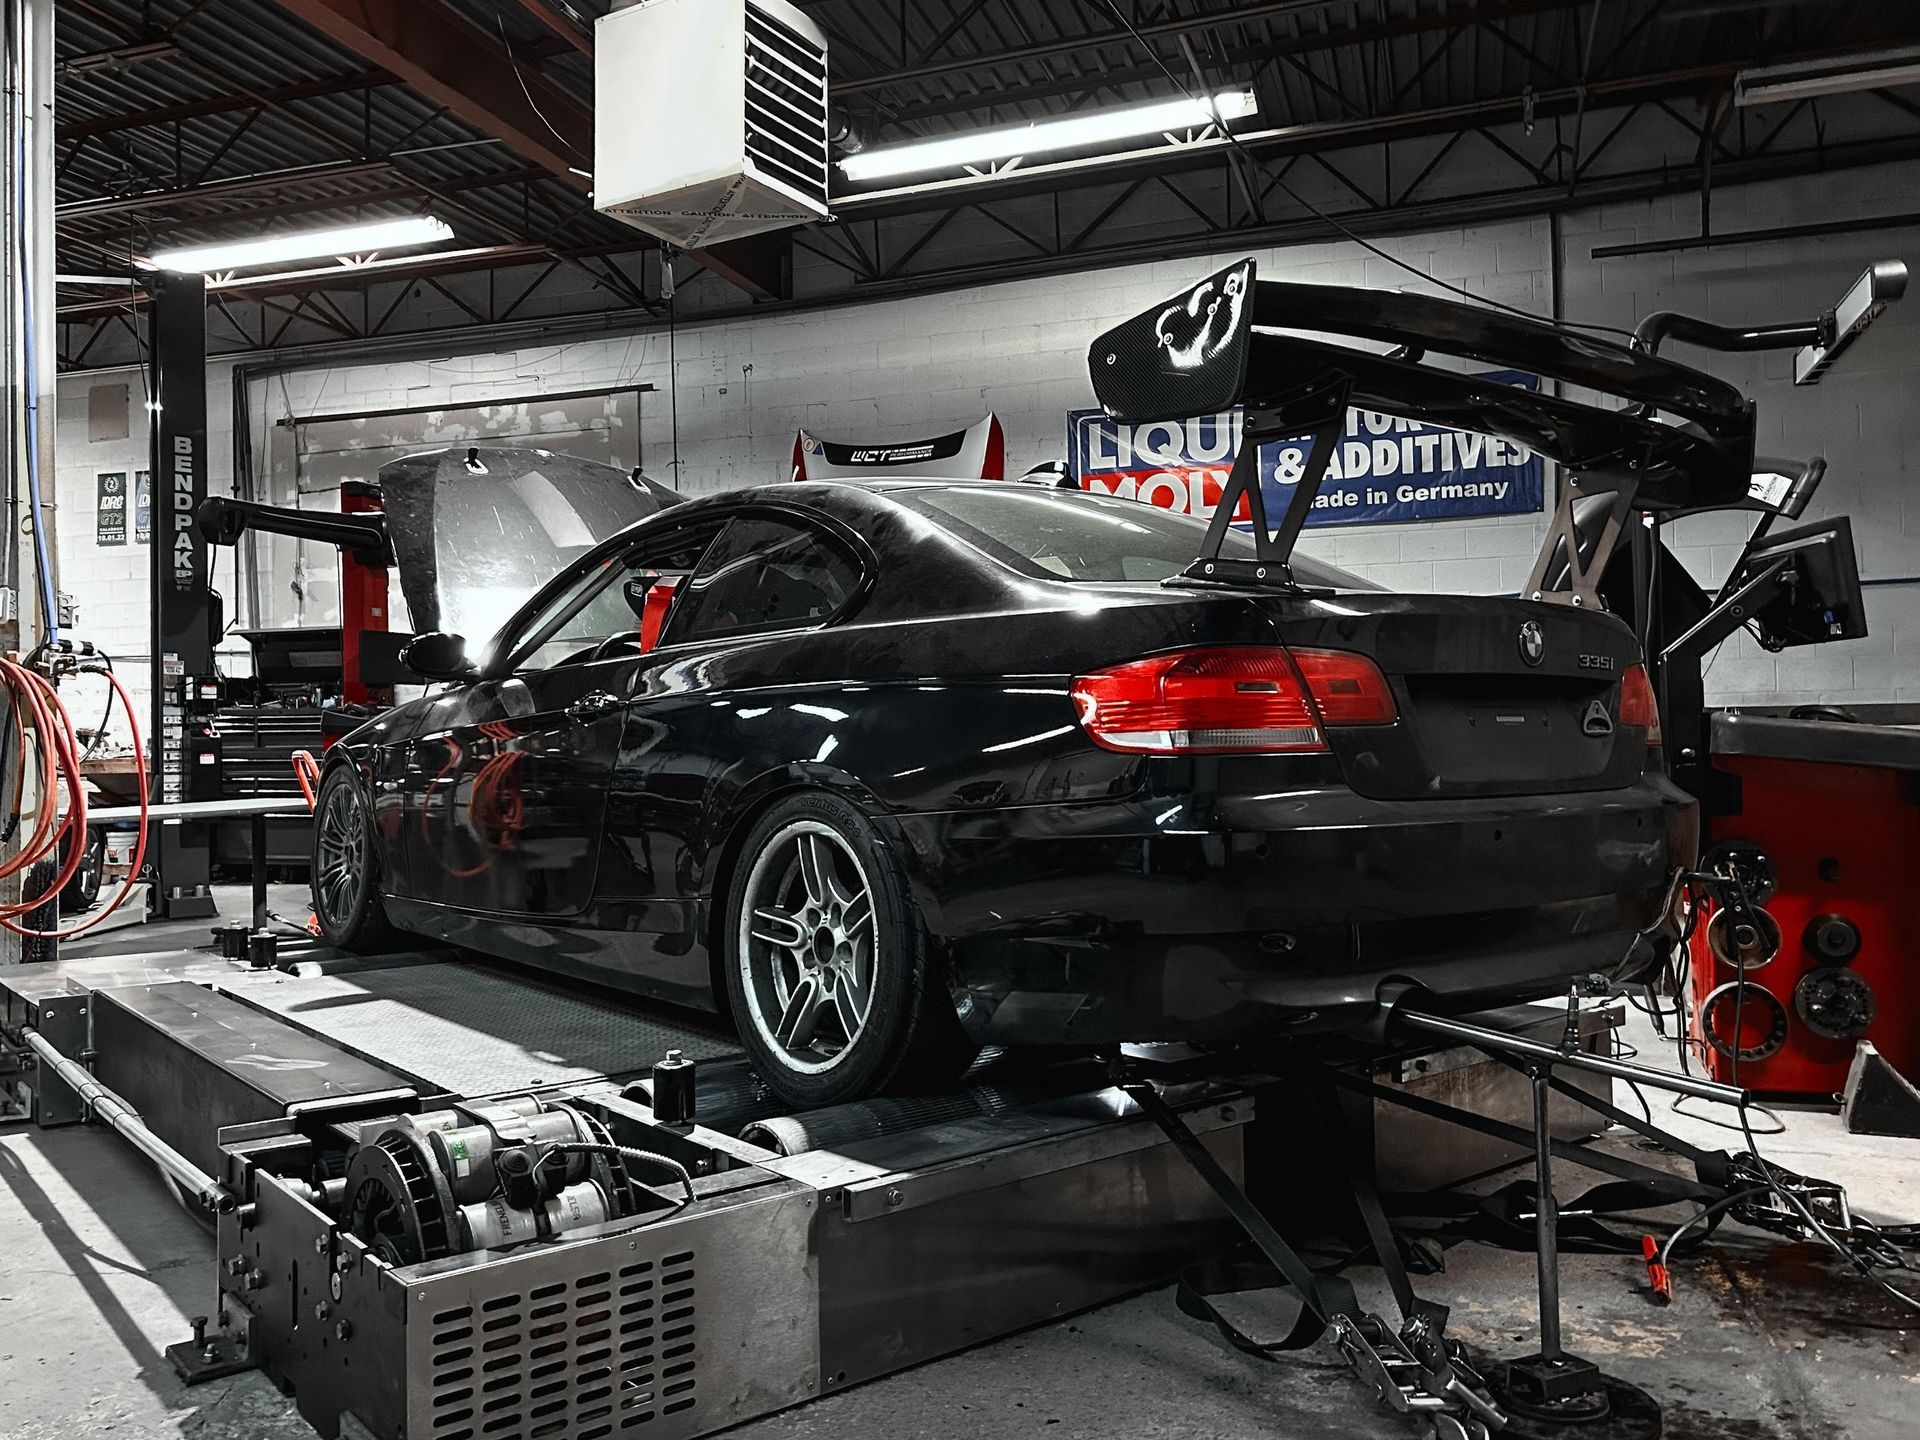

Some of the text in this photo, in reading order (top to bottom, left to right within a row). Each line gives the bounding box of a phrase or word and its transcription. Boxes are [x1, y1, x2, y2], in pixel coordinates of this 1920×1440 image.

[604, 208, 671, 216] ATTENTION
[1273, 433, 1531, 485] & ADDITIVES
[174, 436, 194, 568] BENDPAK
[1311, 481, 1508, 509] ade in Germany
[101, 513, 124, 525] GT2
